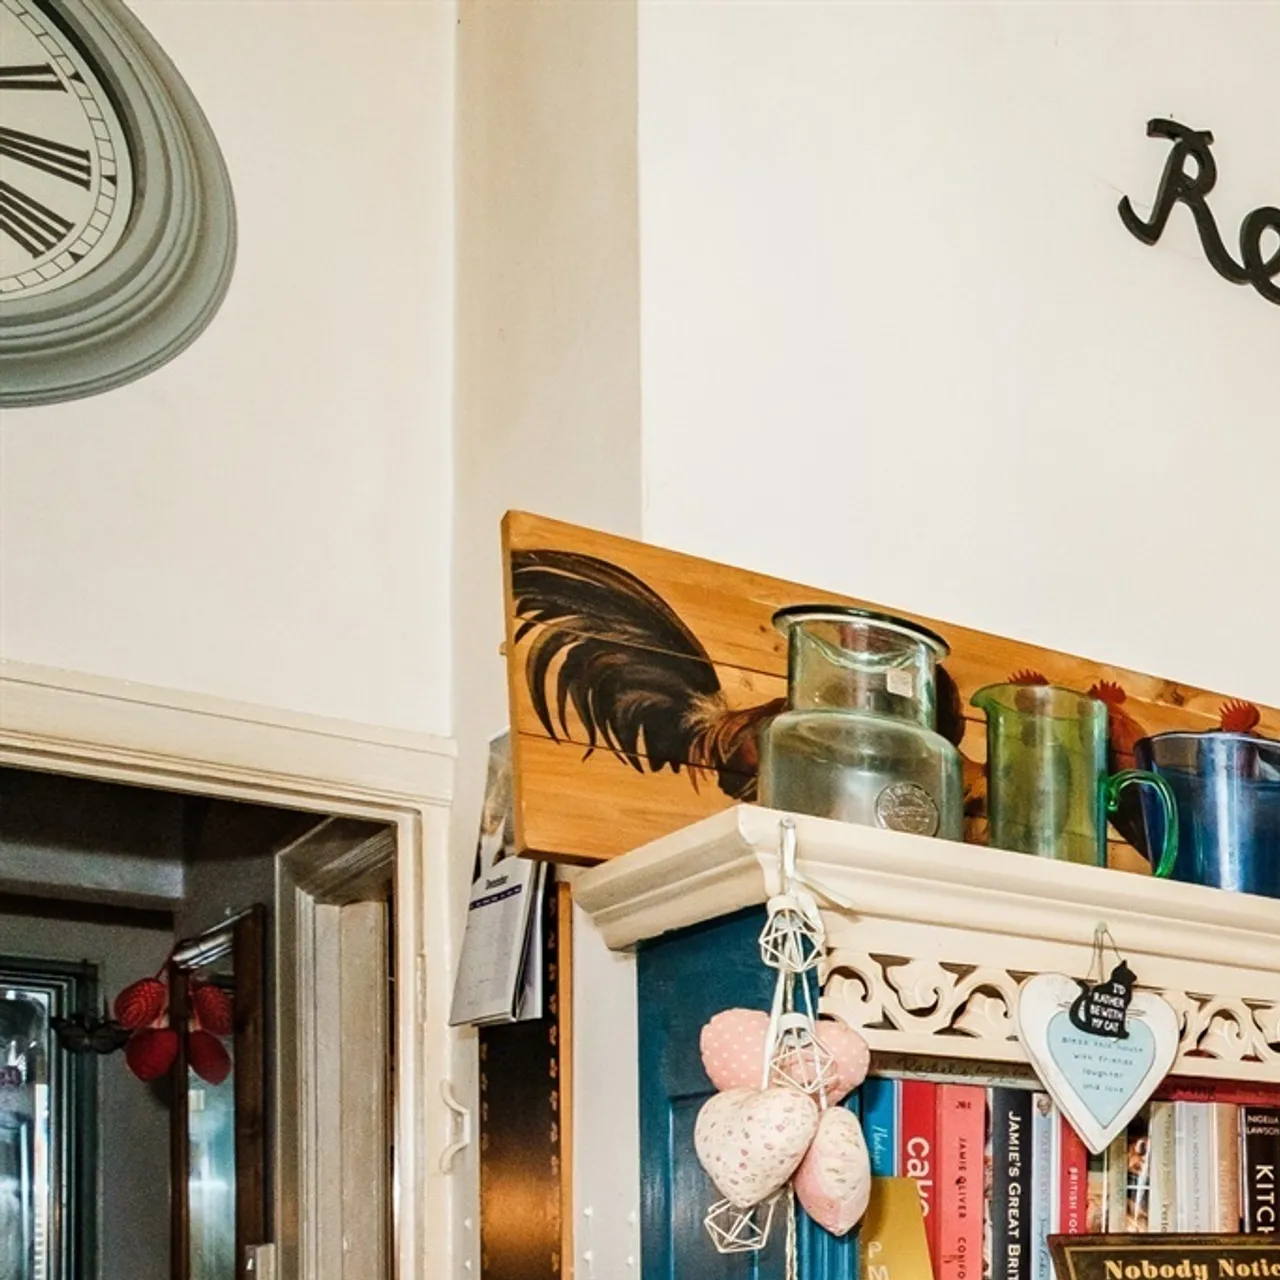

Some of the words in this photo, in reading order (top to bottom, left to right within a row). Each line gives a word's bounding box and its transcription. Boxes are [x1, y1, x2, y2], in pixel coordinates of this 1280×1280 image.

[957, 1137, 968, 1172] JAMIE
[1007, 1110, 1022, 1178] JAMIE'S
[955, 1177, 968, 1219] OLIVER
[1068, 1166, 1079, 1209] BRITISH
[1006, 1182, 1022, 1241] GREAT
